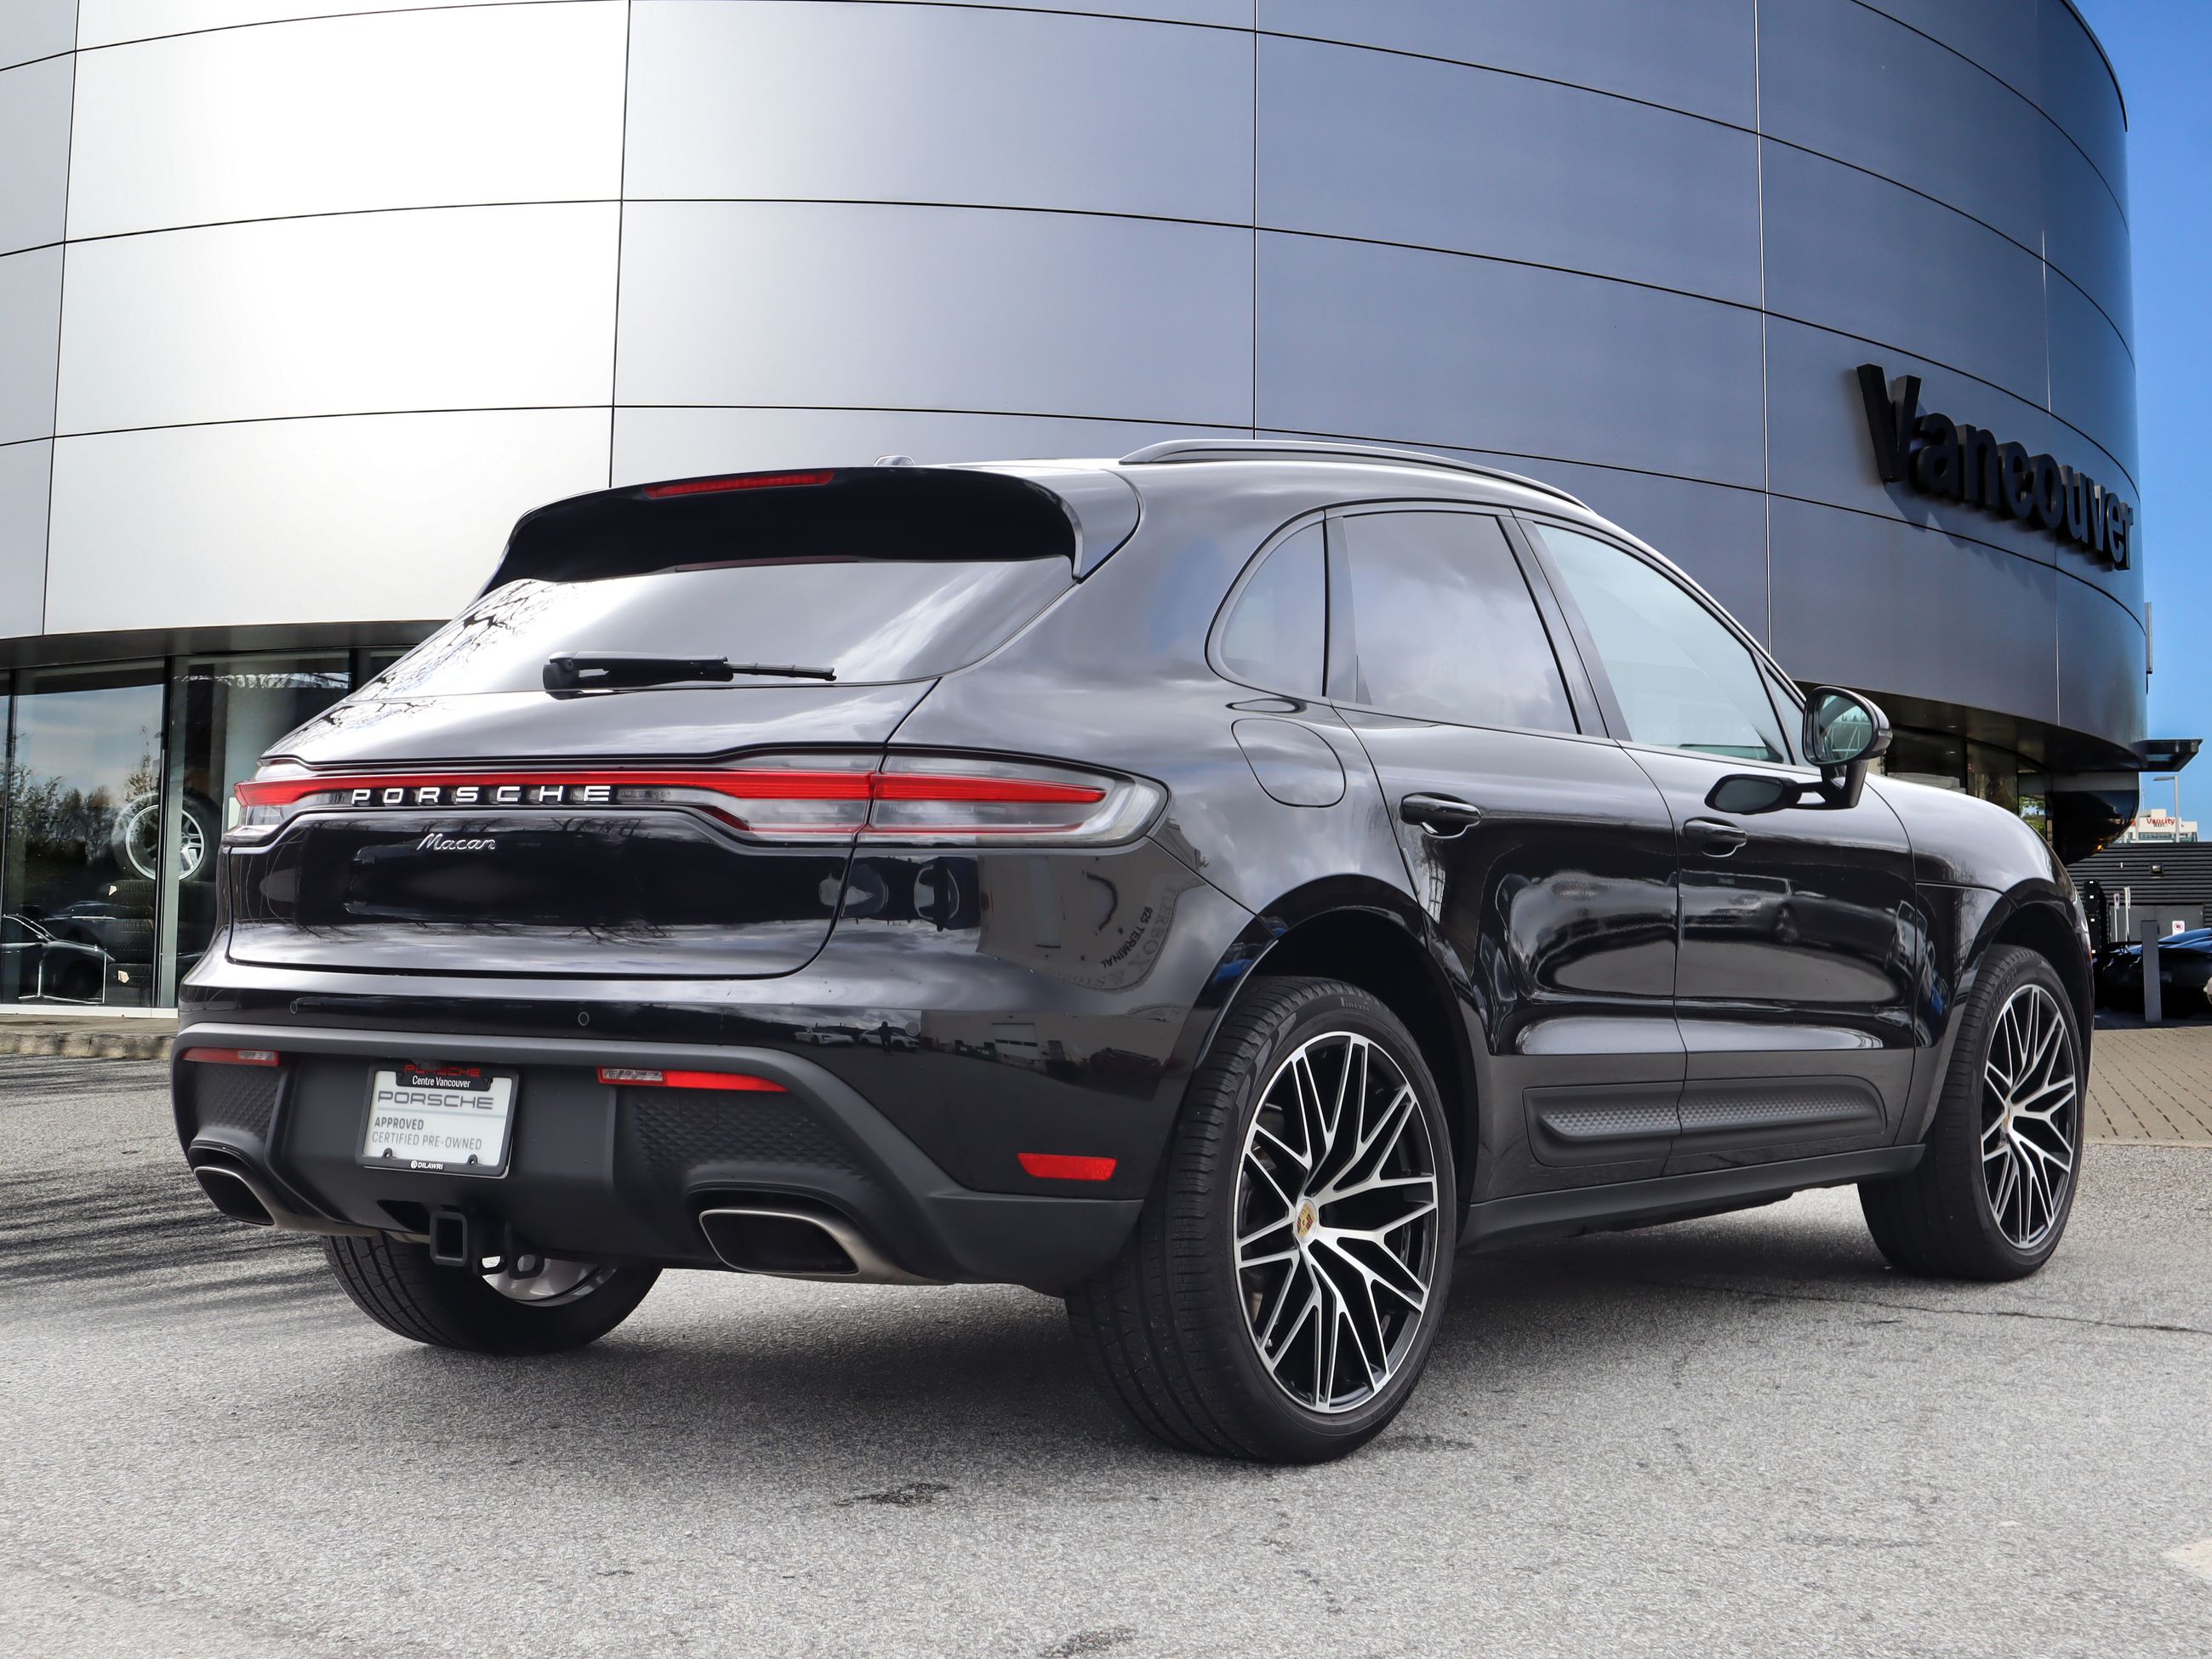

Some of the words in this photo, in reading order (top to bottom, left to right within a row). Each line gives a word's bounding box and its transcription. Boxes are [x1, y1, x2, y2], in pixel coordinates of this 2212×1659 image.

[1856, 362, 2134, 571] Vancouver
[351, 785, 611, 805] PORSCHE
[417, 833, 497, 852] Macan
[412, 1075, 435, 1086] Centre
[436, 1076, 471, 1088] Vancouver
[378, 1091, 494, 1109] PORSCHE
[374, 1116, 425, 1131] APPROVED
[372, 1131, 419, 1146] CERTIFIED
[422, 1134, 482, 1150] PRE-OWNED
[417, 1161, 444, 1170] DILAWRI
